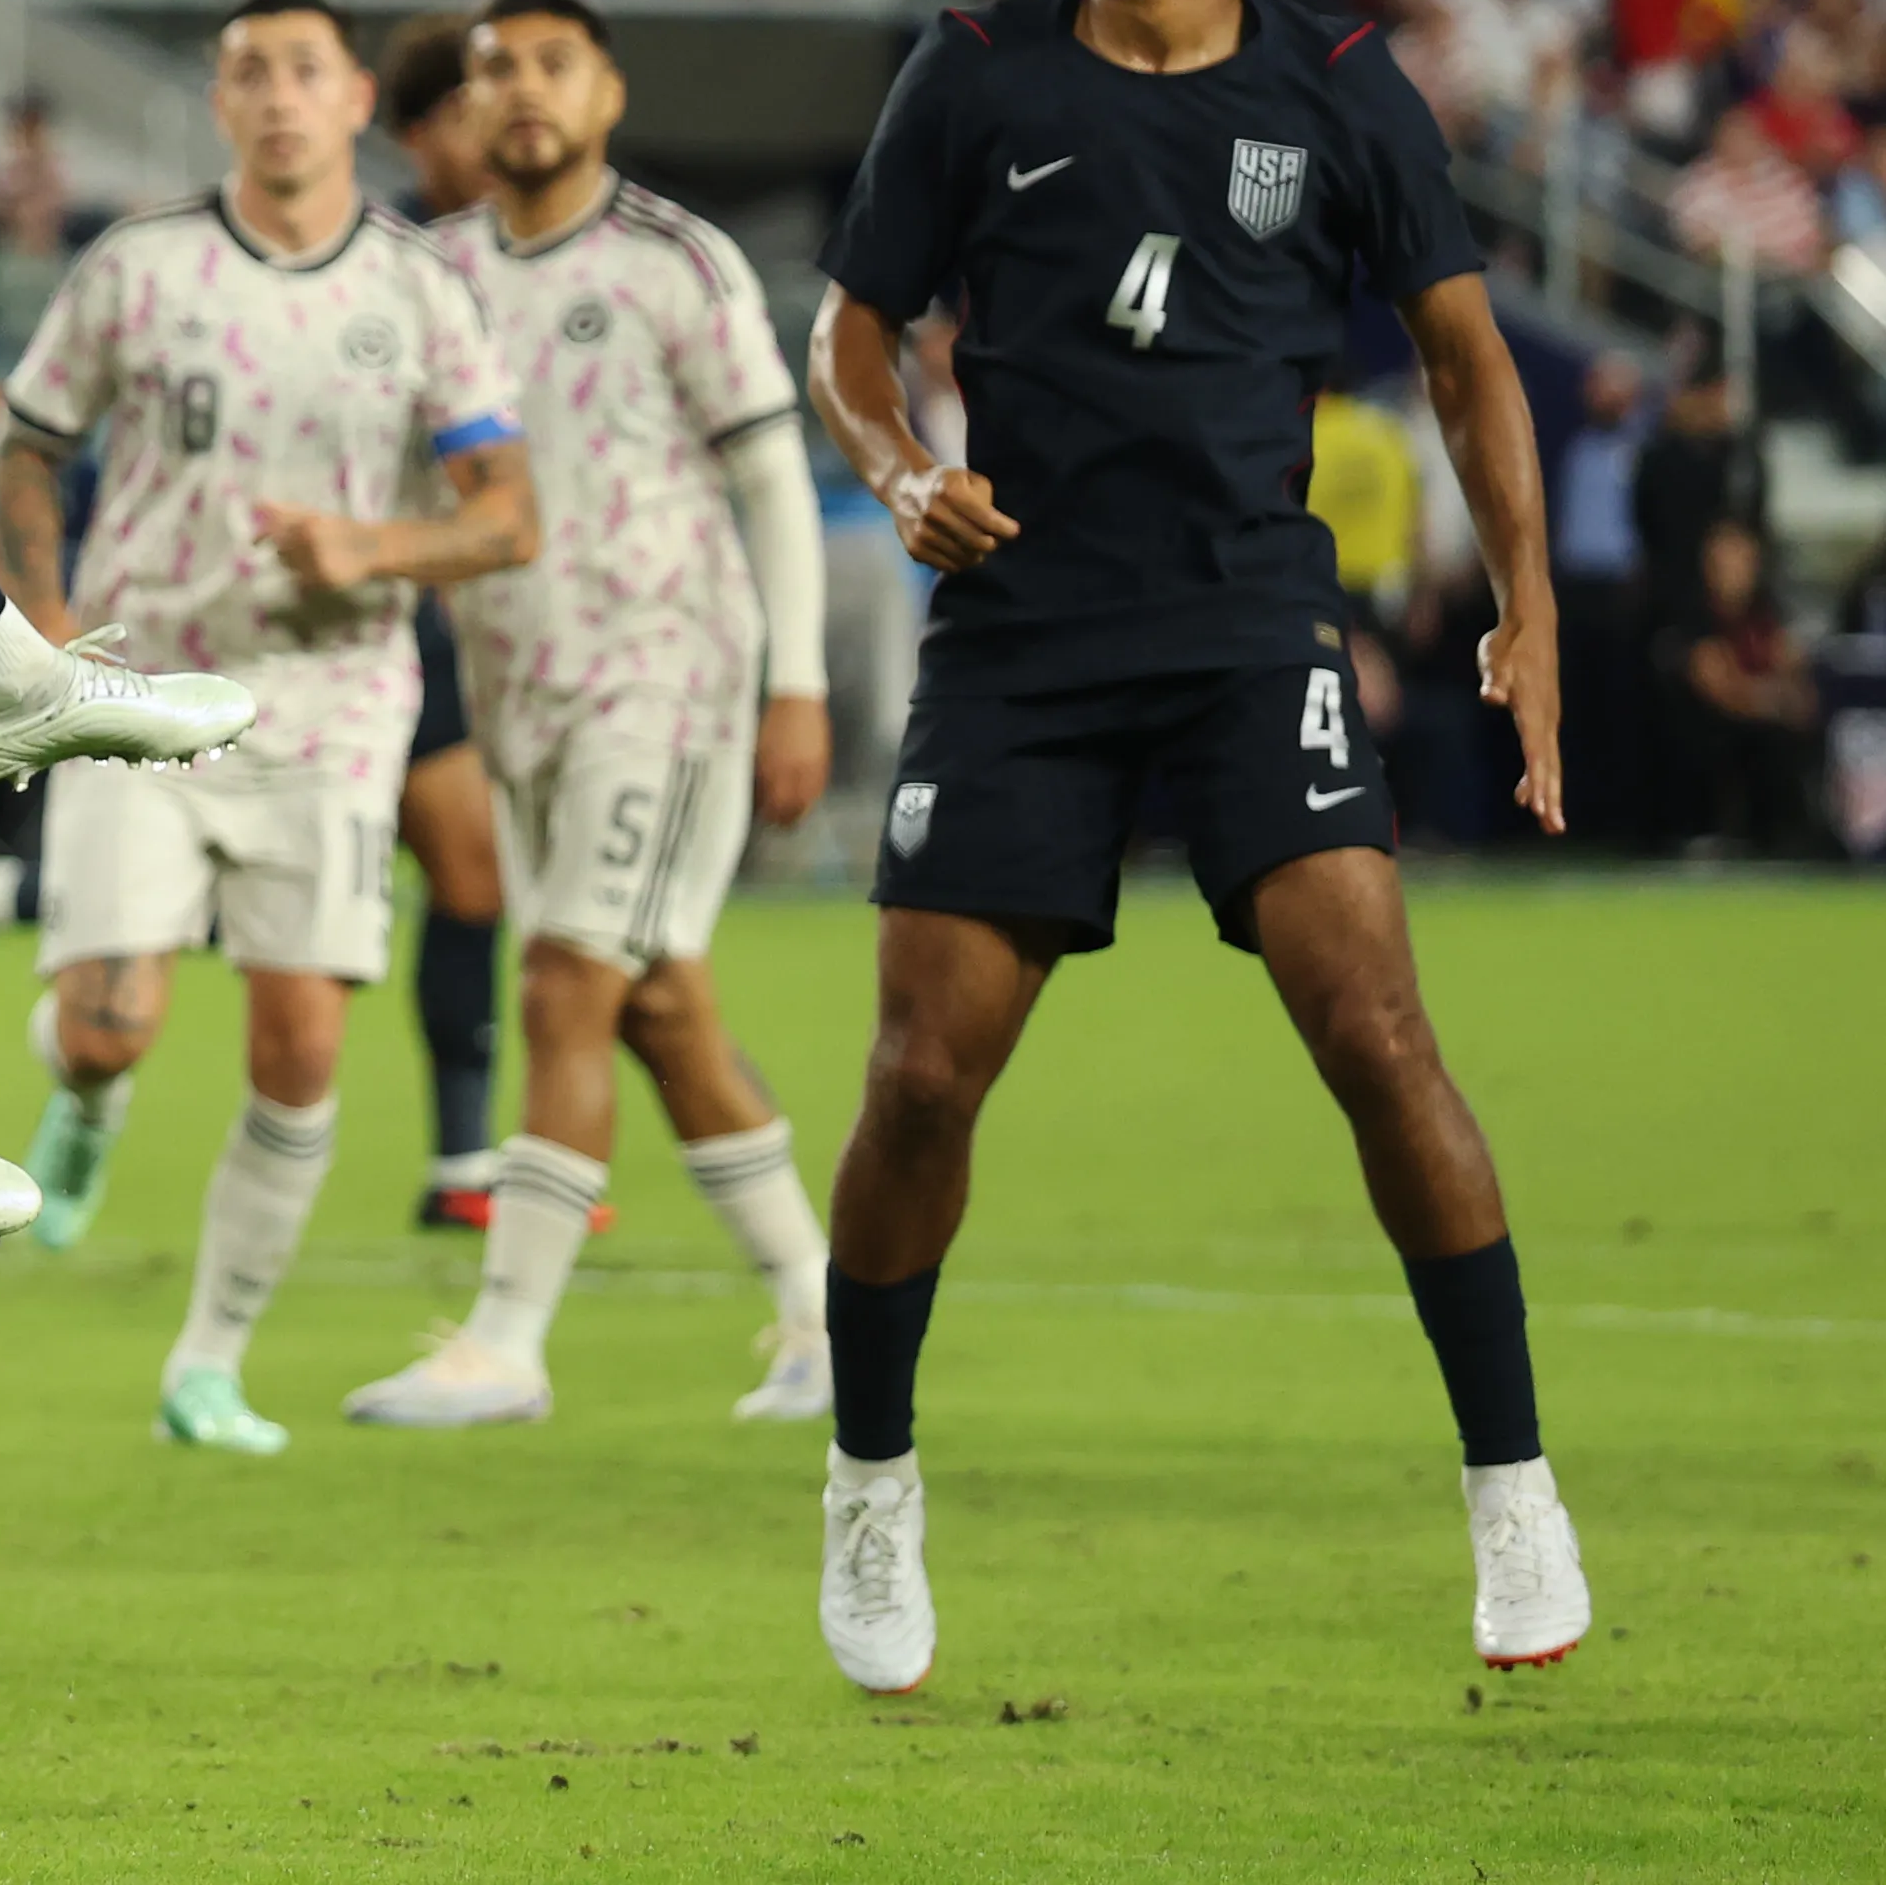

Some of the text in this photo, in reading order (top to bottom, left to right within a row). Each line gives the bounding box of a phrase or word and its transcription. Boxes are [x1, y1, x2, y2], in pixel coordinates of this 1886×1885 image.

[1238, 144, 1300, 189] USA
[1105, 230, 1181, 351] 4
[1298, 666, 1350, 770] 4
[596, 786, 652, 869] 5
